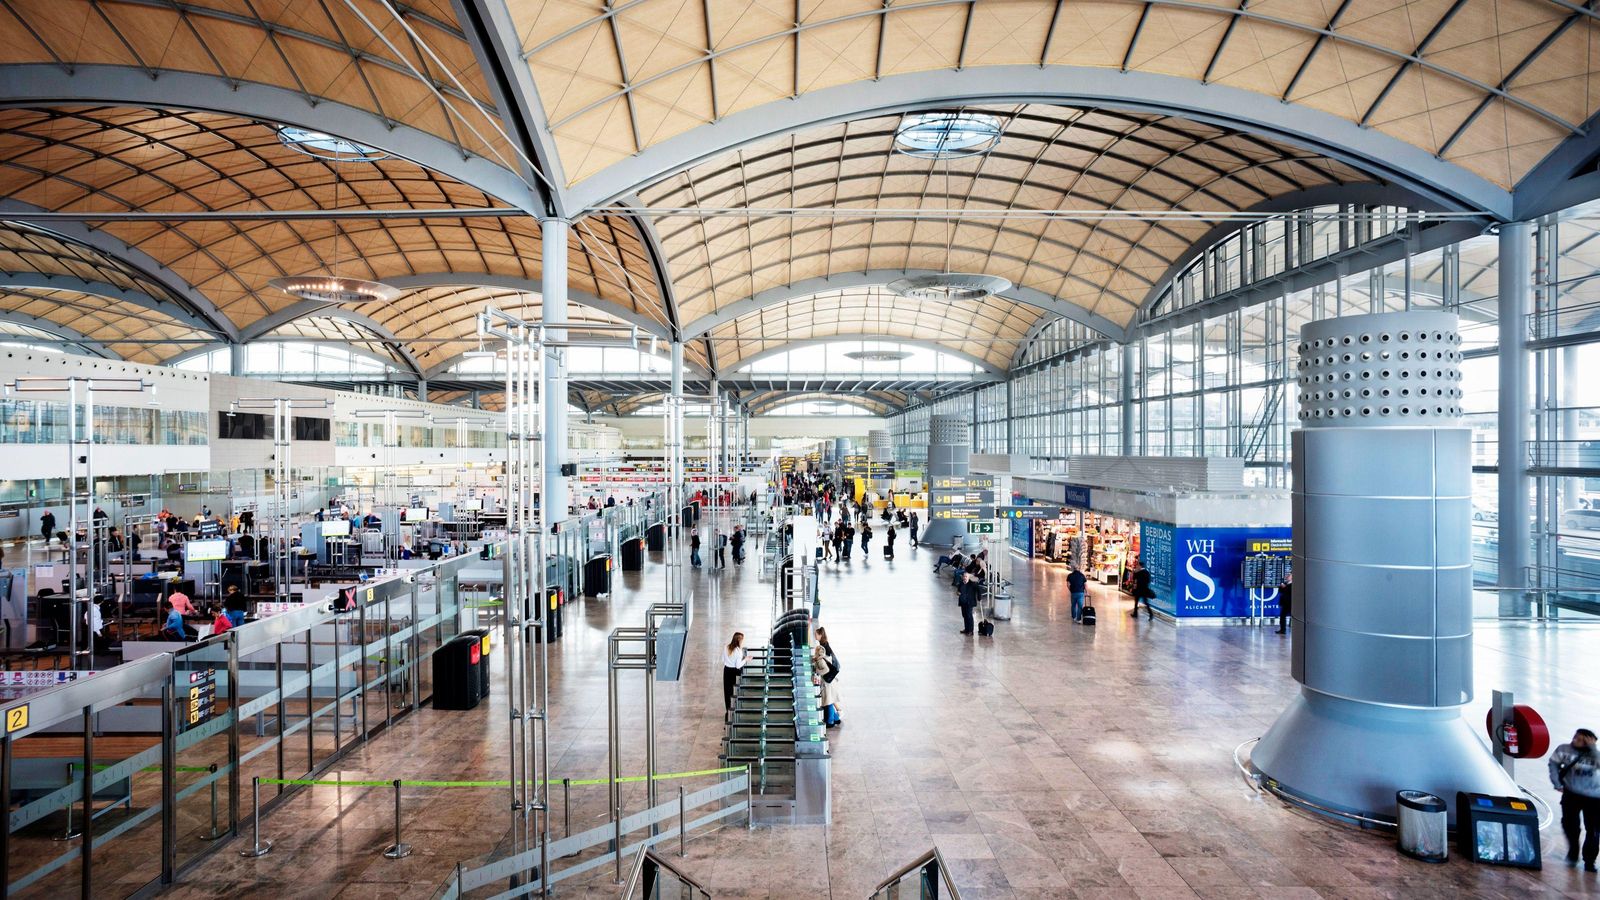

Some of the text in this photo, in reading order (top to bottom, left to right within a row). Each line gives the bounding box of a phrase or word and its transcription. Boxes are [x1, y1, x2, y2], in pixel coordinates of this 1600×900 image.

[1145, 526, 1172, 541] BEBIDAS
[1186, 539, 1215, 553] WH
[1185, 553, 1216, 603] S
[12, 710, 22, 728] 2
